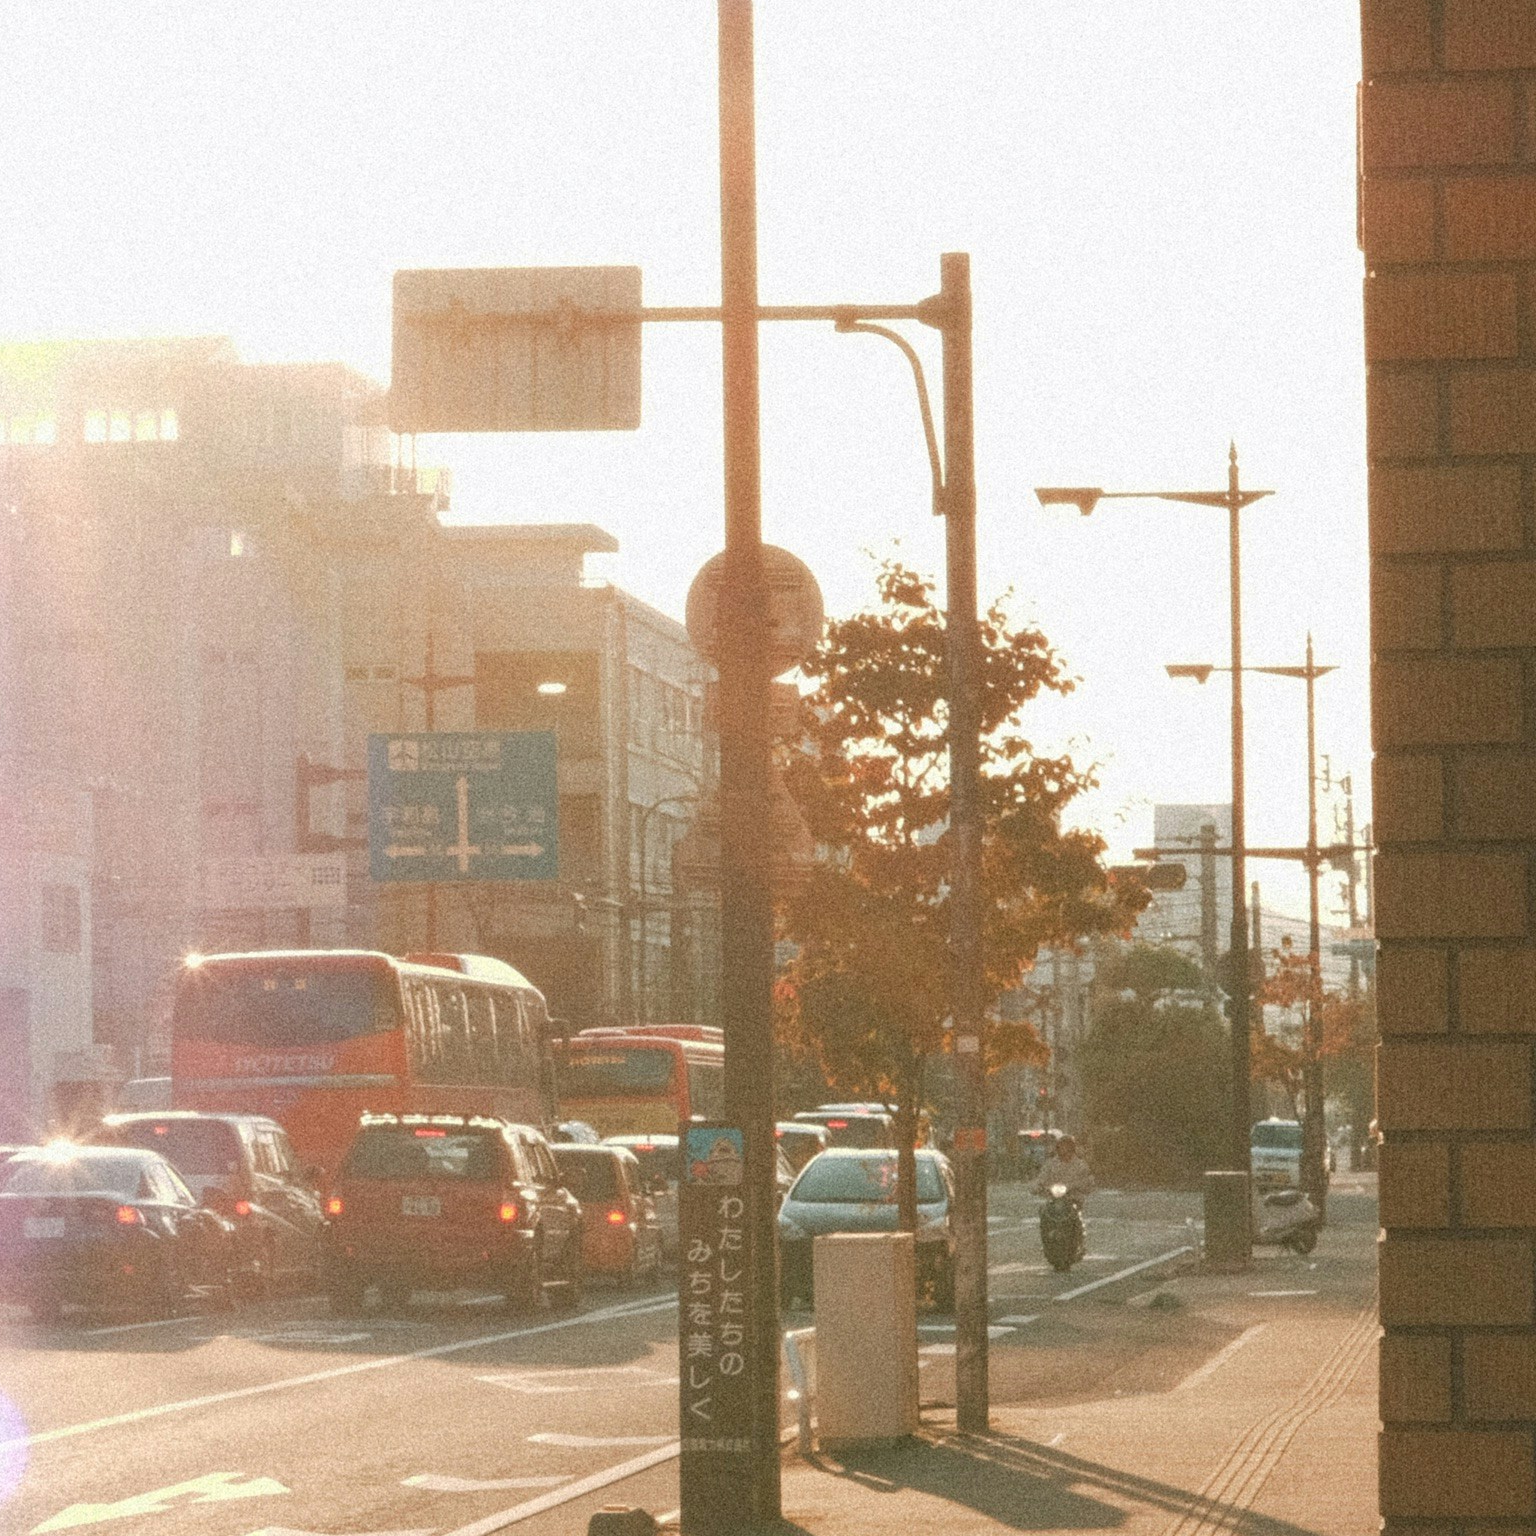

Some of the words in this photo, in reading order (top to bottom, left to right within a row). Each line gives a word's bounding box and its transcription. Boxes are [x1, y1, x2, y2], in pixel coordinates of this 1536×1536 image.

[687, 1239, 712, 1419] みちを美しく
[718, 1195, 744, 1376] わたしたちの
